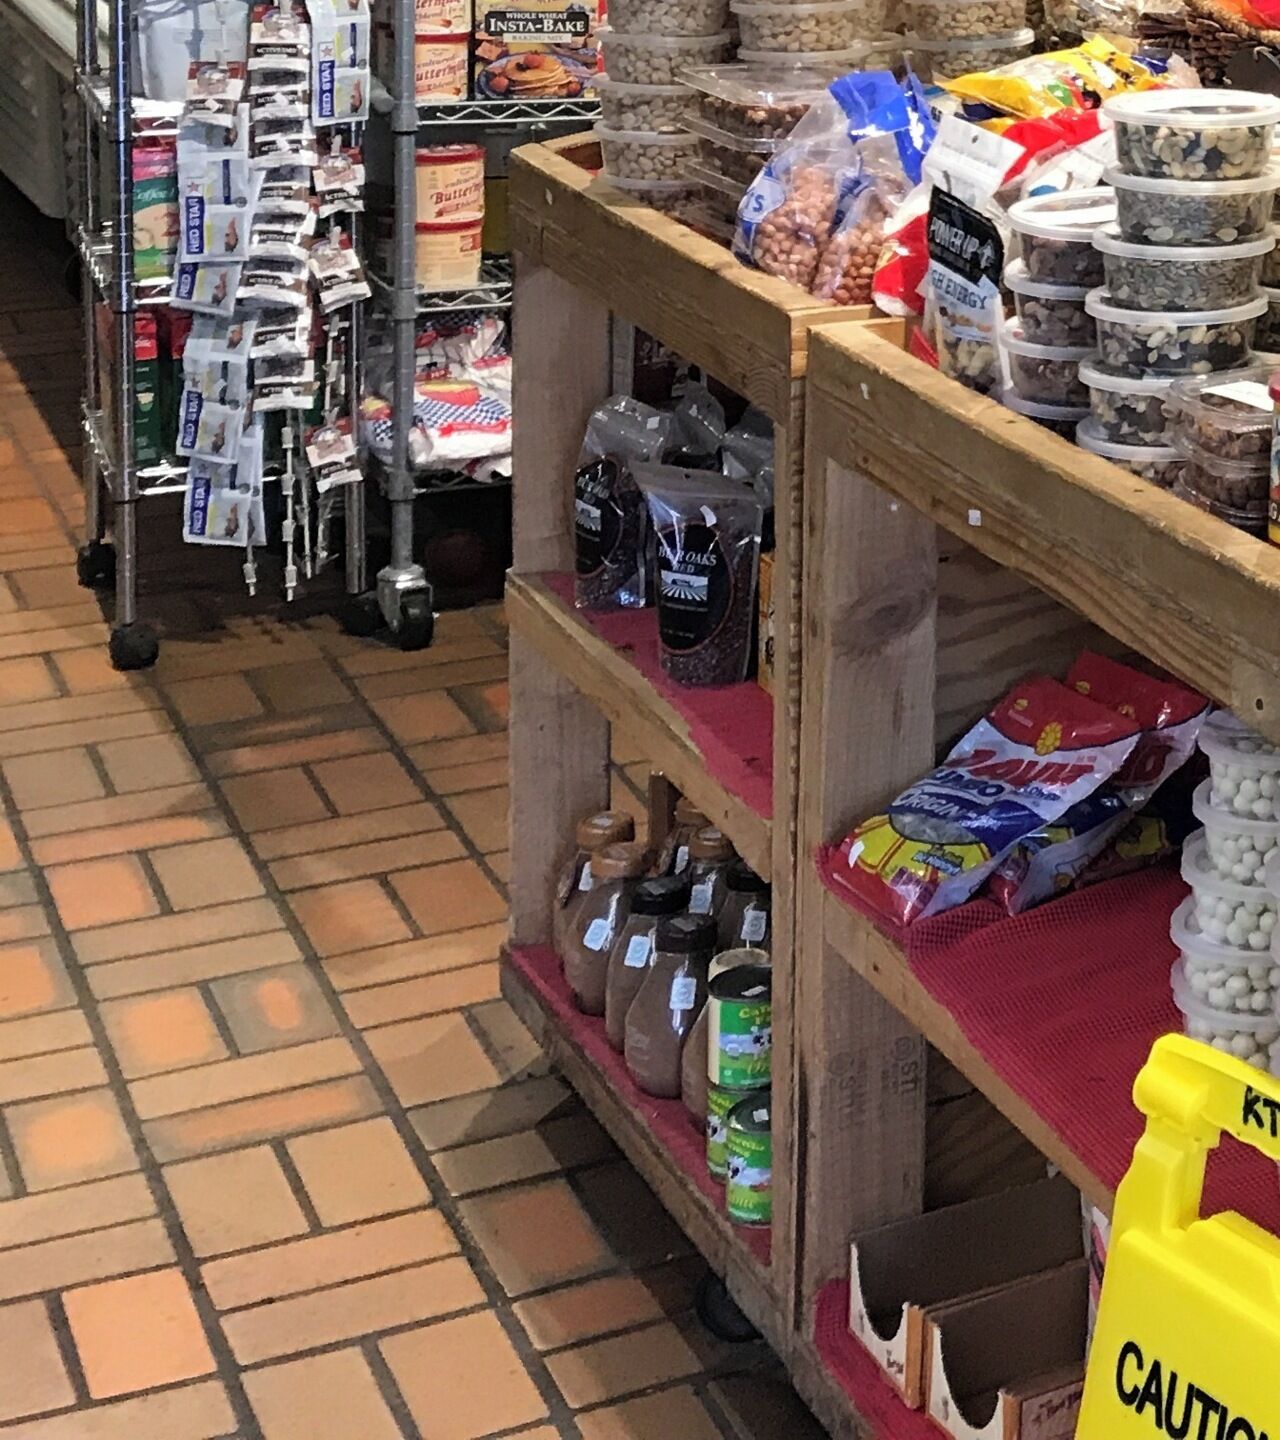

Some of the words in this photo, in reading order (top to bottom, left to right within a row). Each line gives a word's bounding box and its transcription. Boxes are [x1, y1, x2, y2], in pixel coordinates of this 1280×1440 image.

[488, 18, 585, 34] INSTA-BAKE
[506, 12, 536, 20] WHOLE
[537, 12, 568, 21] WHEAT
[321, 63, 334, 93] STAR
[415, 61, 465, 83] uttermilk
[321, 95, 334, 118] RED
[430, 181, 484, 206] Butterm
[188, 228, 203, 255] RED
[930, 216, 965, 256] POWER
[963, 232, 980, 260] UP
[945, 275, 988, 310] ENERGY
[893, 791, 972, 817] ORIGIN
[1116, 1340, 1268, 1440] CAUTIO
